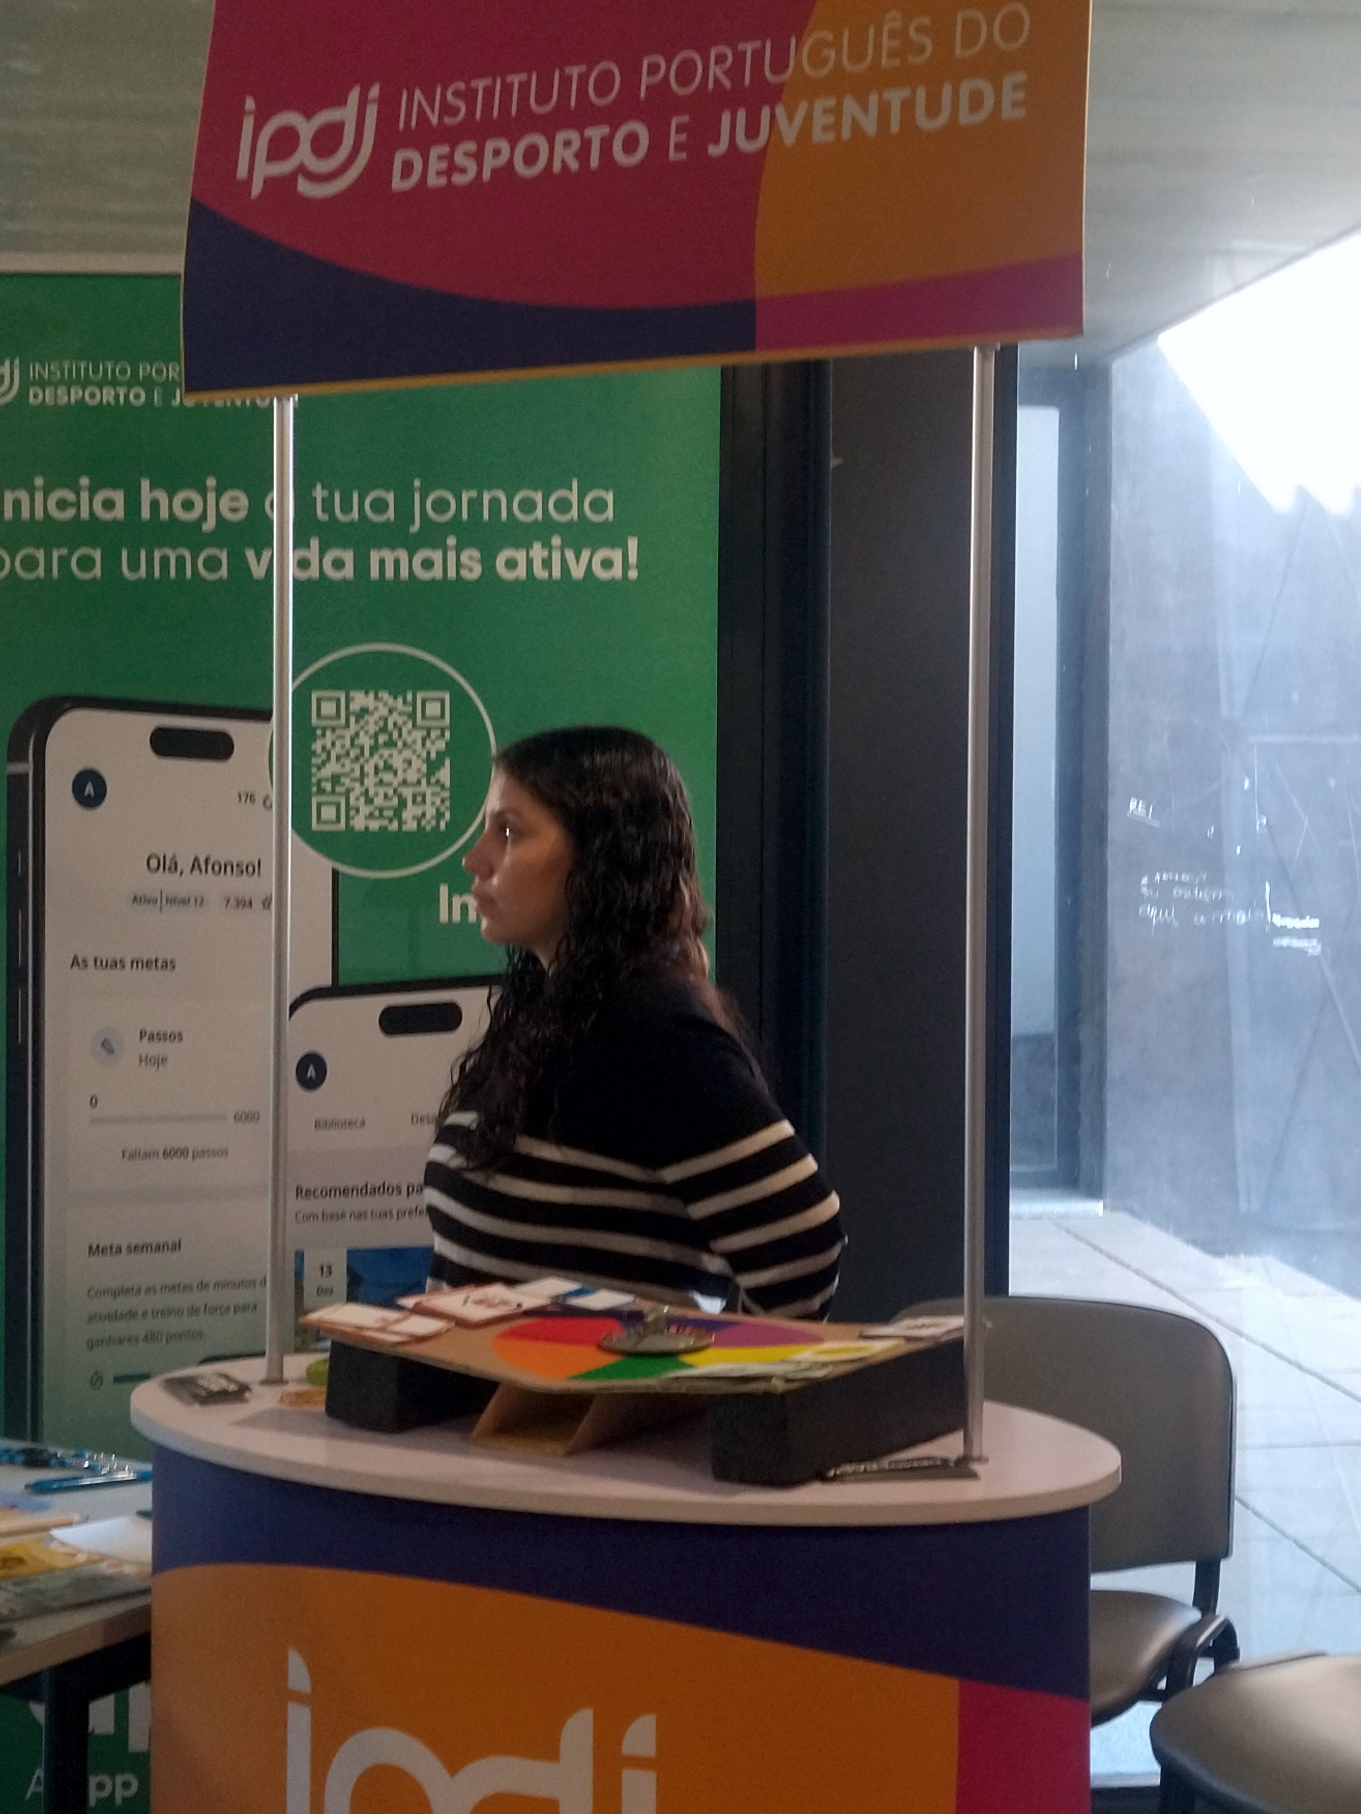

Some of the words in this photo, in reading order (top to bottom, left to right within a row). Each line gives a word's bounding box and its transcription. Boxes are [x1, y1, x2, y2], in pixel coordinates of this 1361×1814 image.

[398, 60, 621, 132] INSTITUTO
[640, 10, 932, 101] PORTUGUÊS
[955, 2, 1031, 59] DO
[236, 81, 380, 199] ipdj
[391, 121, 650, 192] DESPORTO
[669, 116, 688, 161] E
[708, 72, 1028, 157] JUVENTUDE
[30, 361, 131, 382] INSTITUTO
[29, 386, 146, 406] DESPORTO
[140, 475, 249, 533] hoje
[312, 482, 395, 523] tua
[409, 478, 615, 533] jornada
[121, 546, 228, 581] uma
[245, 536, 354, 581] vda
[369, 536, 482, 581] mais
[495, 536, 640, 581] ativa!
[146, 852, 184, 877] Olá,
[70, 953, 88, 971] As
[93, 955, 126, 971] tuas
[130, 955, 176, 972] metas
[139, 1027, 184, 1044] Passos
[139, 1054, 168, 1071] Hoje
[295, 1181, 402, 1200] Recomendados
[88, 1242, 122, 1258] Meta
[126, 1238, 182, 1255] semanal
